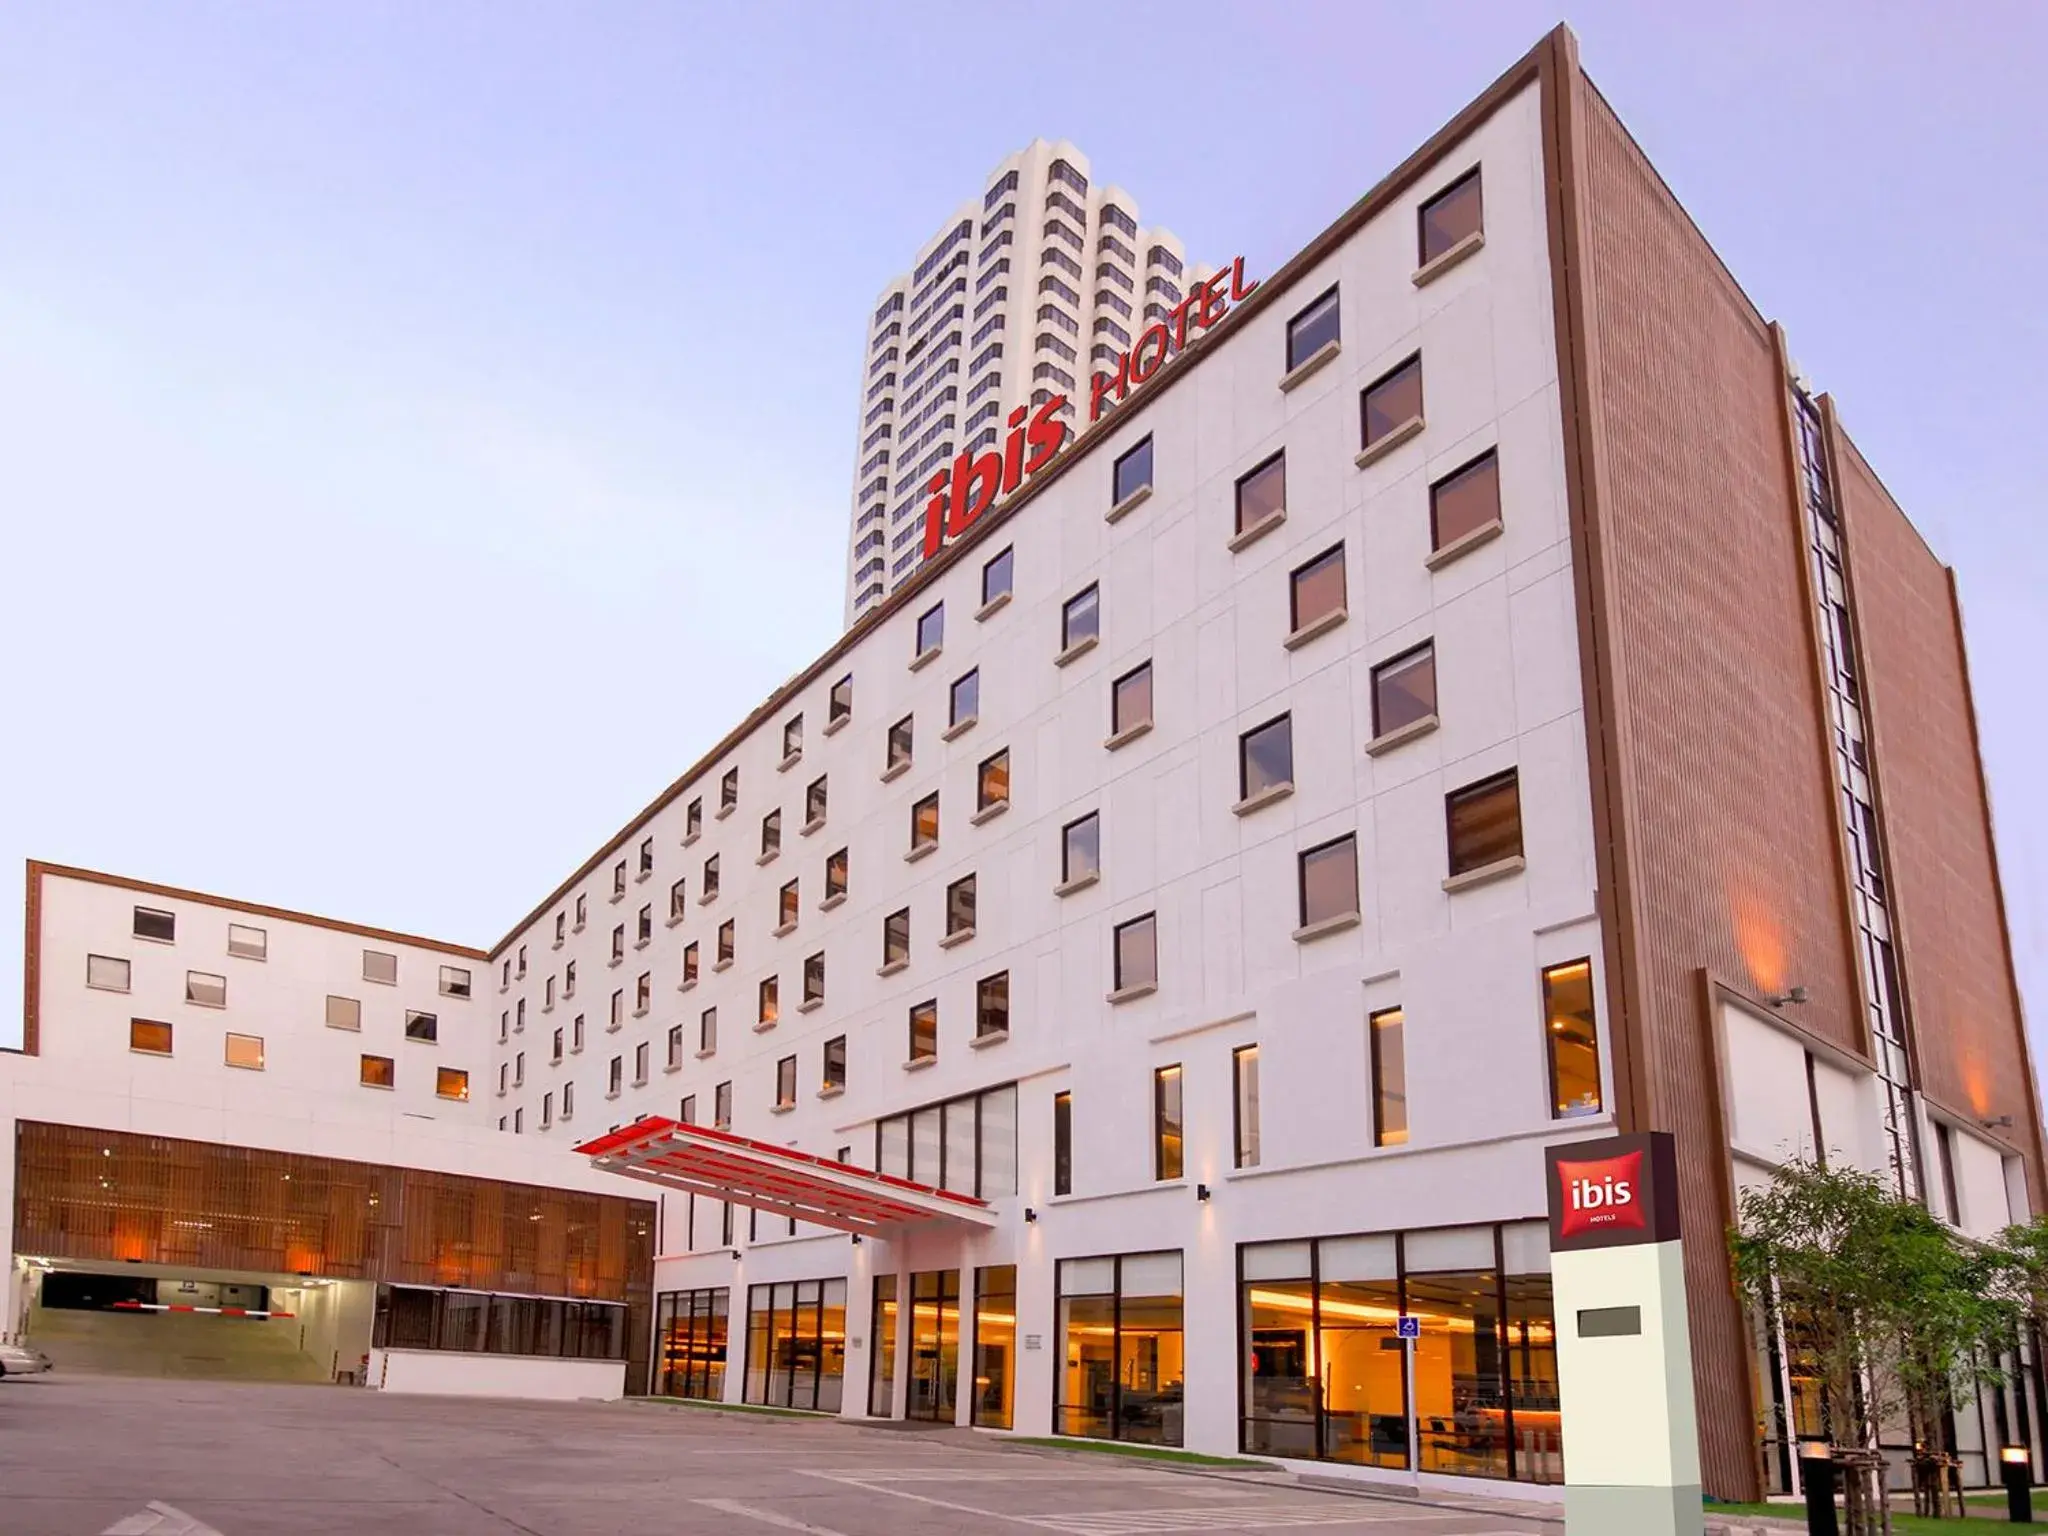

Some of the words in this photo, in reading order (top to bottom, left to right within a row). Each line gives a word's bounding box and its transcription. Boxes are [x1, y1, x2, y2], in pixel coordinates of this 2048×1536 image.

[923, 395, 1067, 560] ibis
[1090, 255, 1260, 422] HOTEL
[1572, 1176, 1631, 1209] ibis
[1590, 1213, 1616, 1222] HOTELS
